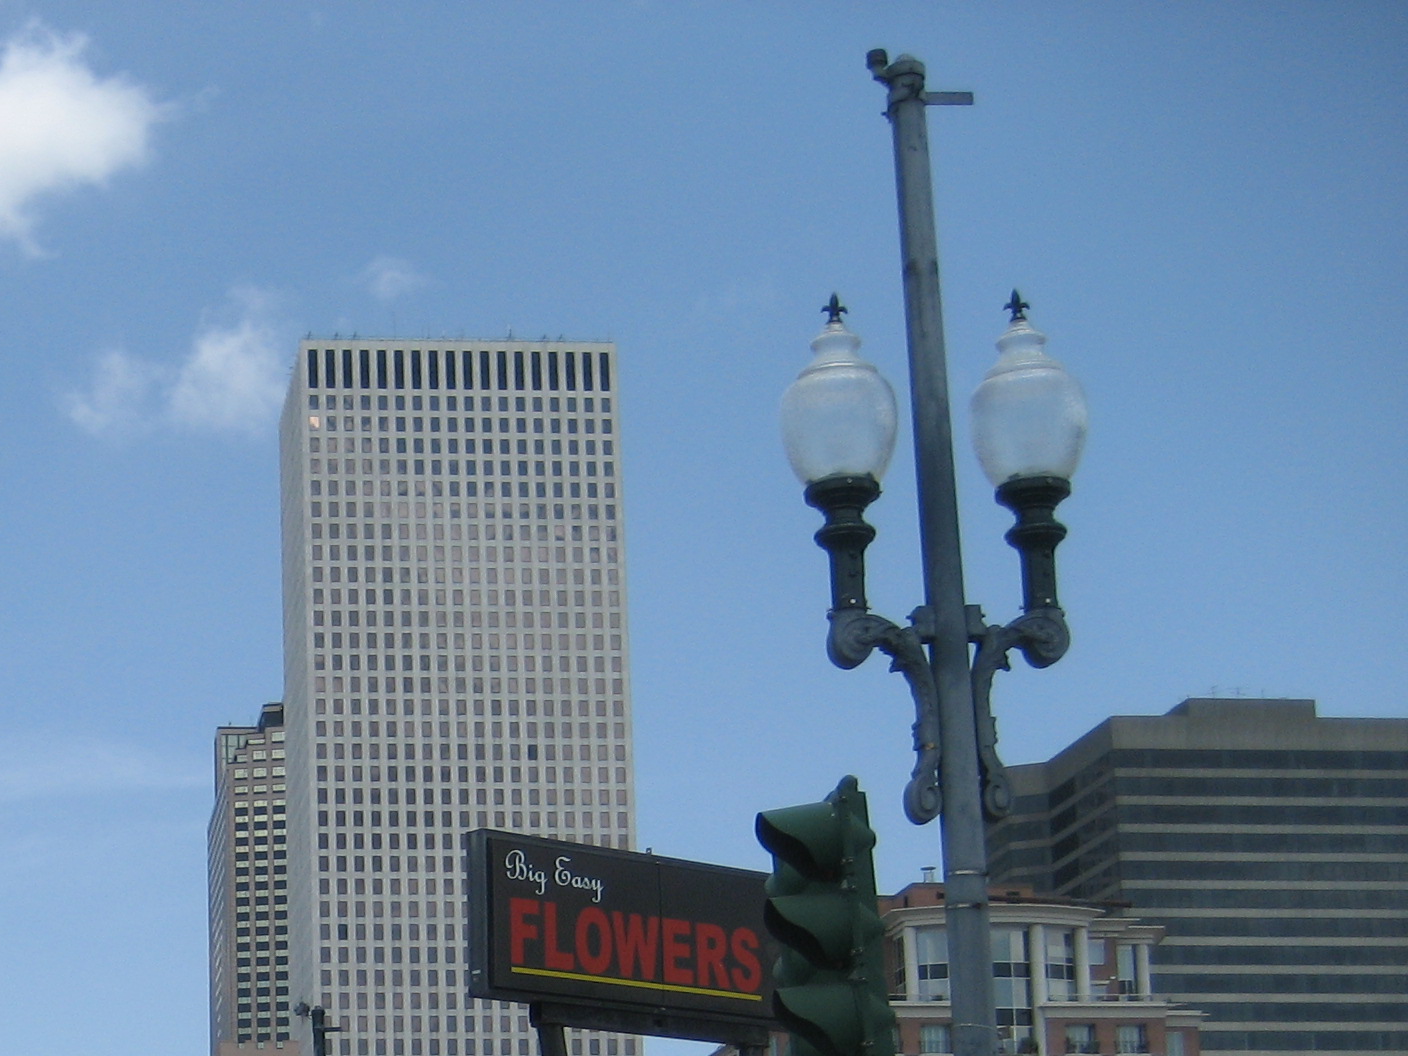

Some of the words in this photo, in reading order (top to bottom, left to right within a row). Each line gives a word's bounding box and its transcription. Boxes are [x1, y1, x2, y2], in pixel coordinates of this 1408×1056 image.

[505, 849, 548, 895] Big
[554, 856, 605, 903] Easy
[509, 897, 763, 993] FLOWERS
